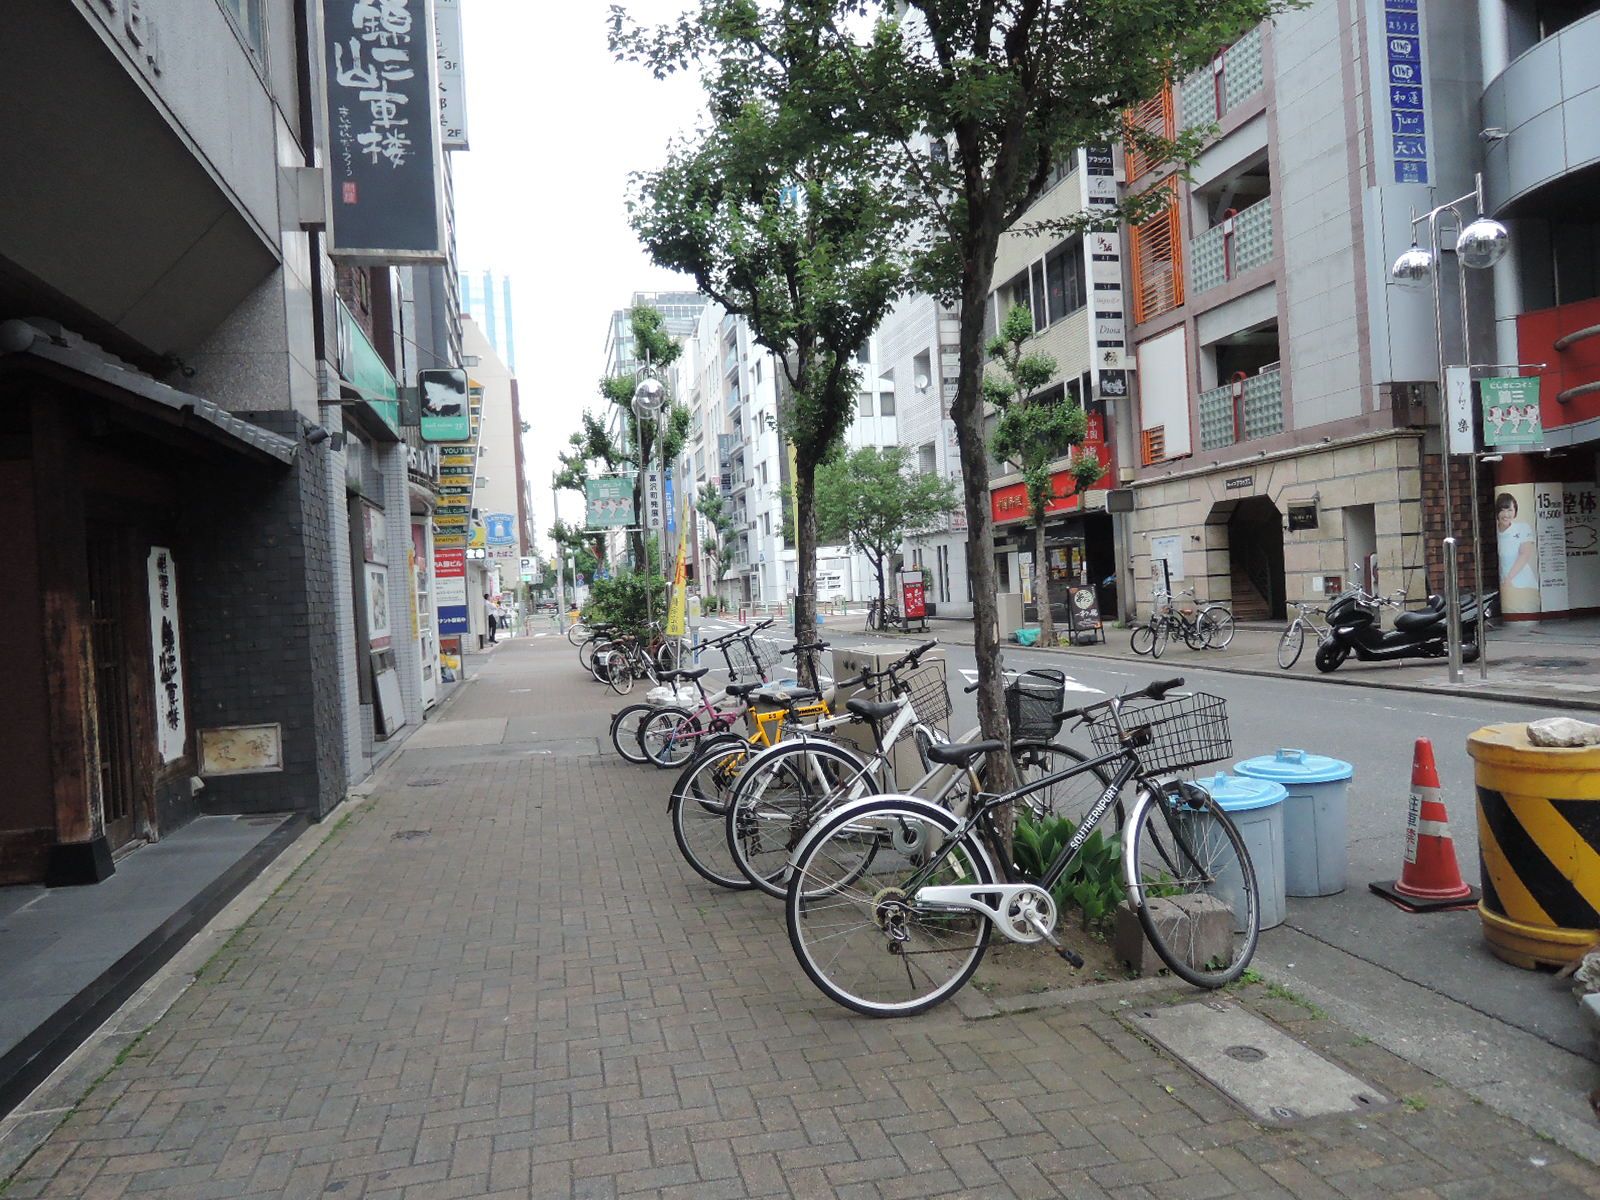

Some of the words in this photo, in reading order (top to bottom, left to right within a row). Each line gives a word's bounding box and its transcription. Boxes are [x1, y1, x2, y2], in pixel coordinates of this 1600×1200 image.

[444, 60, 458, 70] 3F
[447, 128, 462, 138] 2F
[1537, 493, 1550, 509] 15
[1563, 491, 1597, 515] 整体
[1070, 783, 1120, 850] SOUTHERNPORT
